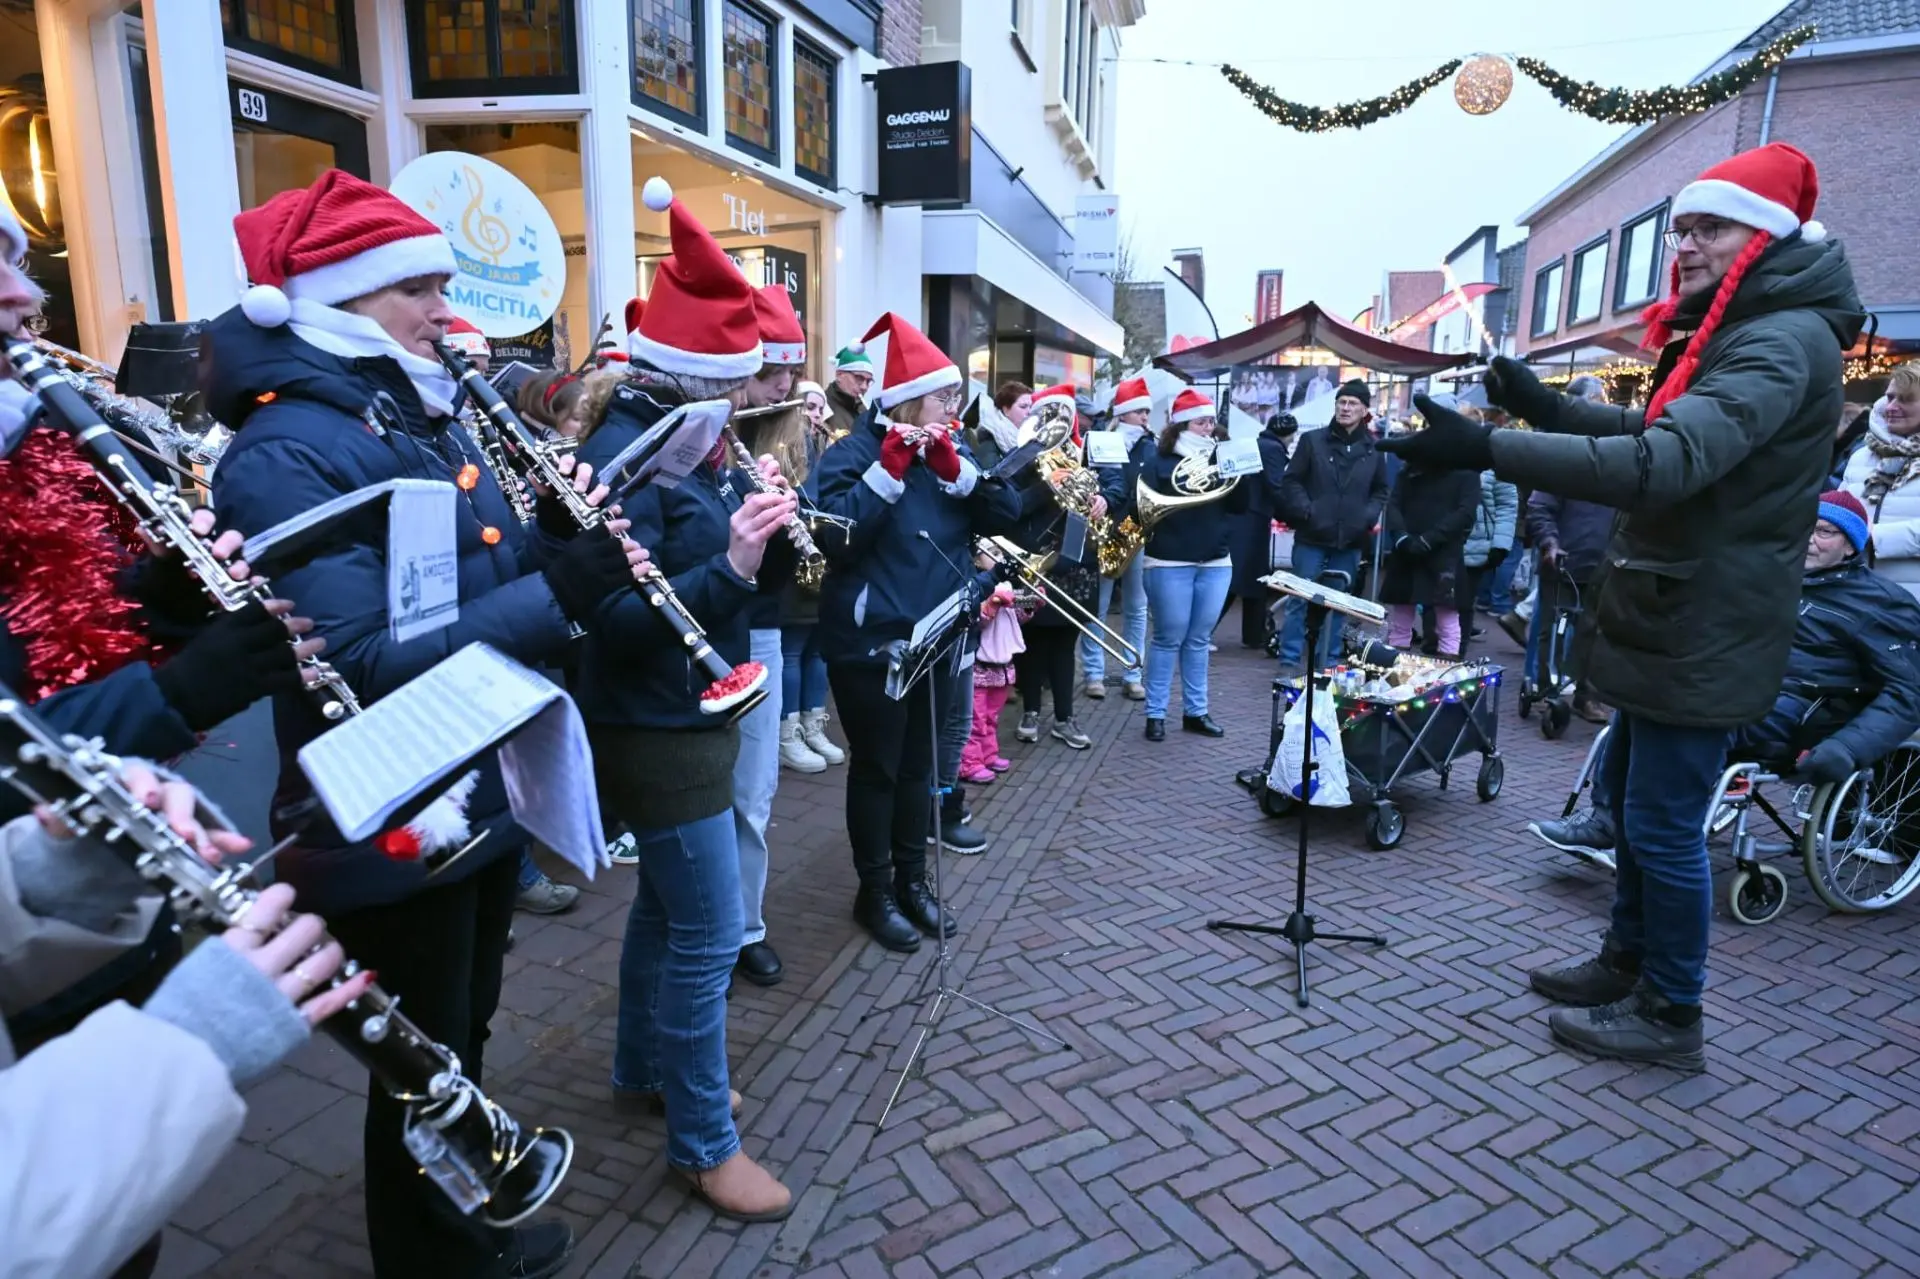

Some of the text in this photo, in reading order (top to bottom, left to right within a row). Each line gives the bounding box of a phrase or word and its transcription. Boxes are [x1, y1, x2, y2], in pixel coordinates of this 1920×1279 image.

[243, 92, 263, 118] 39
[886, 109, 950, 126] GAGGENAU
[487, 268, 521, 281] JAAR
[784, 261, 798, 293] is
[495, 345, 532, 358] DELDEN
